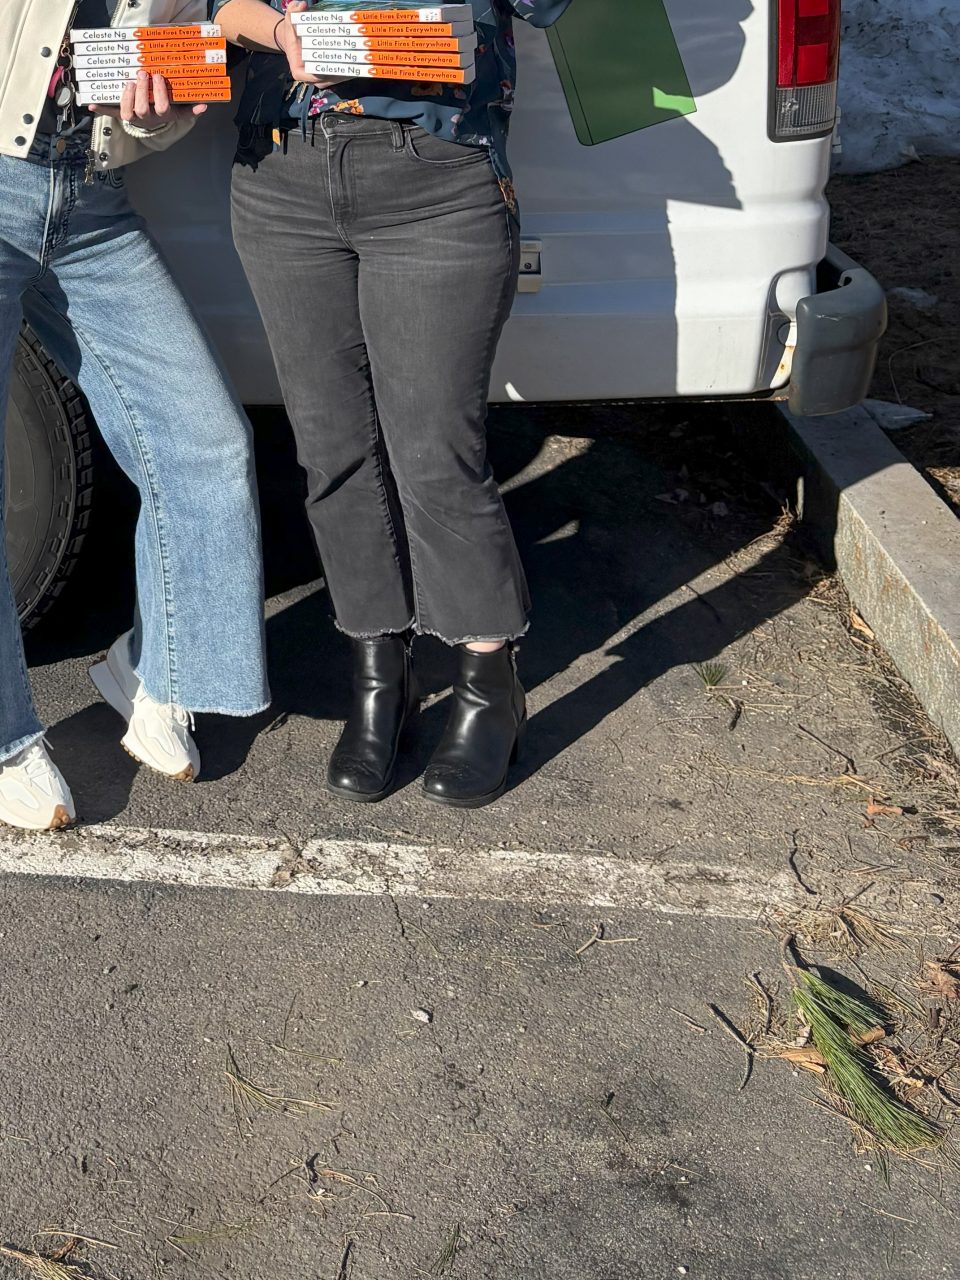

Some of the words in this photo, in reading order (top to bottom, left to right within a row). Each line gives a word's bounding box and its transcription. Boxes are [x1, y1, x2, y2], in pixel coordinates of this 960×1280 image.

[300, 14, 330, 22] Celeste
[114, 31, 127, 39] Ng
[179, 27, 201, 36] Everyw
[338, 27, 351, 35] Ng
[344, 40, 357, 48] Ng
[86, 44, 114, 52] Celeste
[116, 44, 129, 53] Ng
[87, 57, 115, 65] Celeste
[117, 57, 130, 65] Ng
[344, 53, 357, 62] Ng
[86, 70, 114, 78] Celeste
[315, 65, 345, 73] Celeste
[347, 66, 361, 75] Ng
[90, 82, 120, 90] Celeste
[91, 93, 120, 101] Celeste
